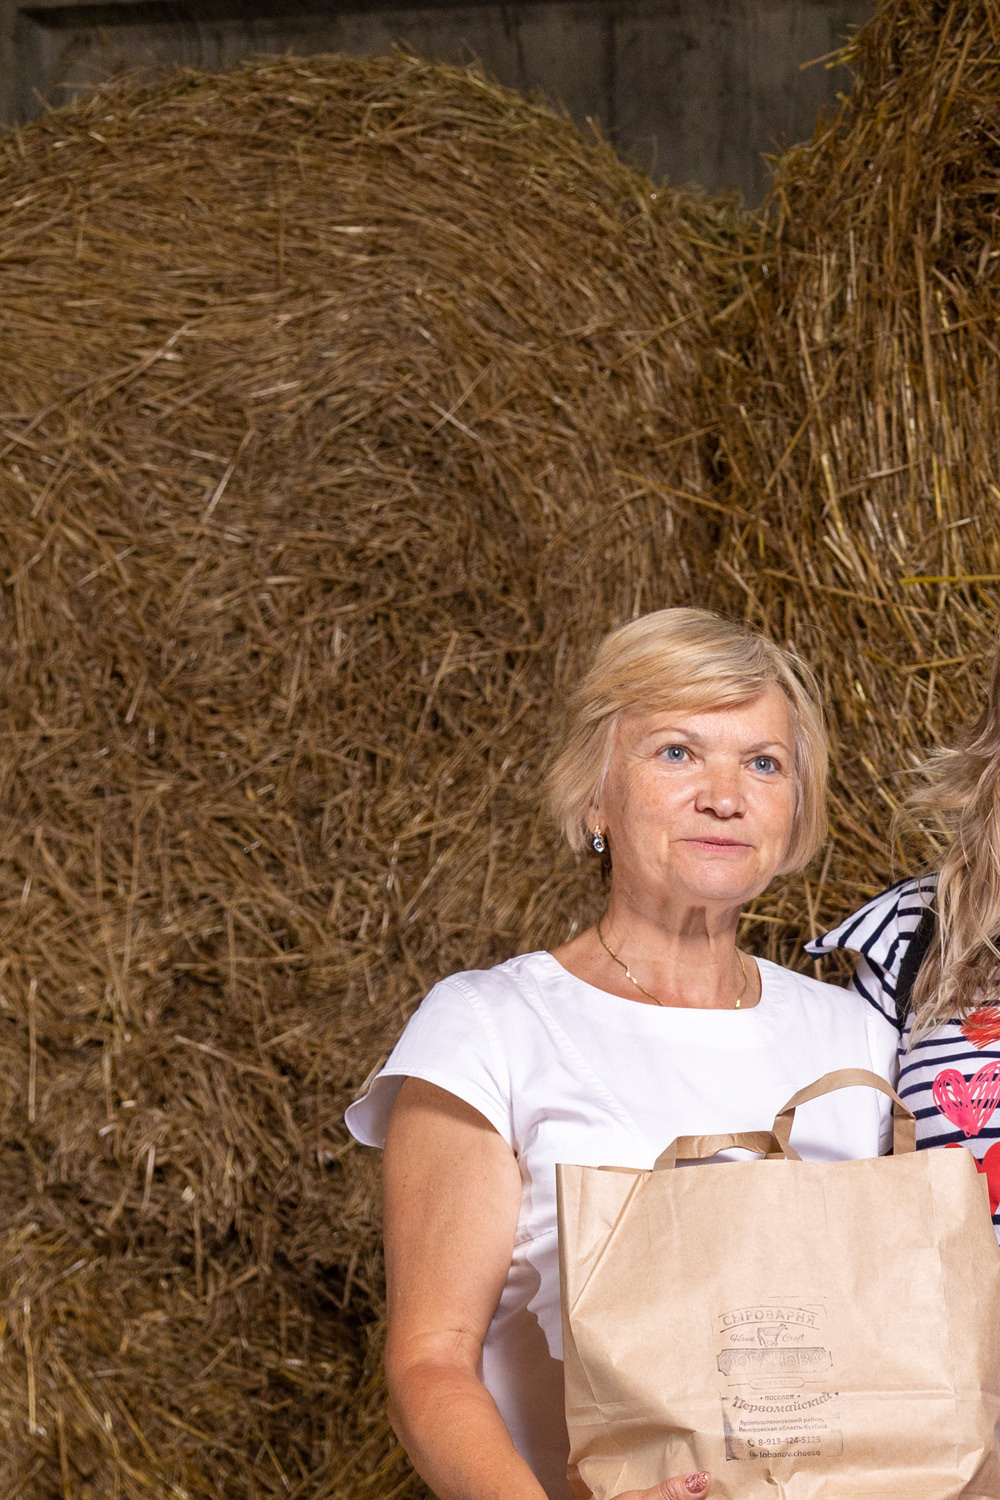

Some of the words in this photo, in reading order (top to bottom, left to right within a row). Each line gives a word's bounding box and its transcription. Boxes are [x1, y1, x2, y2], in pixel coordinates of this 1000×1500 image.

[722, 1309, 816, 1326] СЫРОВАРНЯ
[729, 1333, 756, 1343] Hand
[781, 1333, 805, 1343] Craft
[731, 1391, 833, 1413] Первомайский
